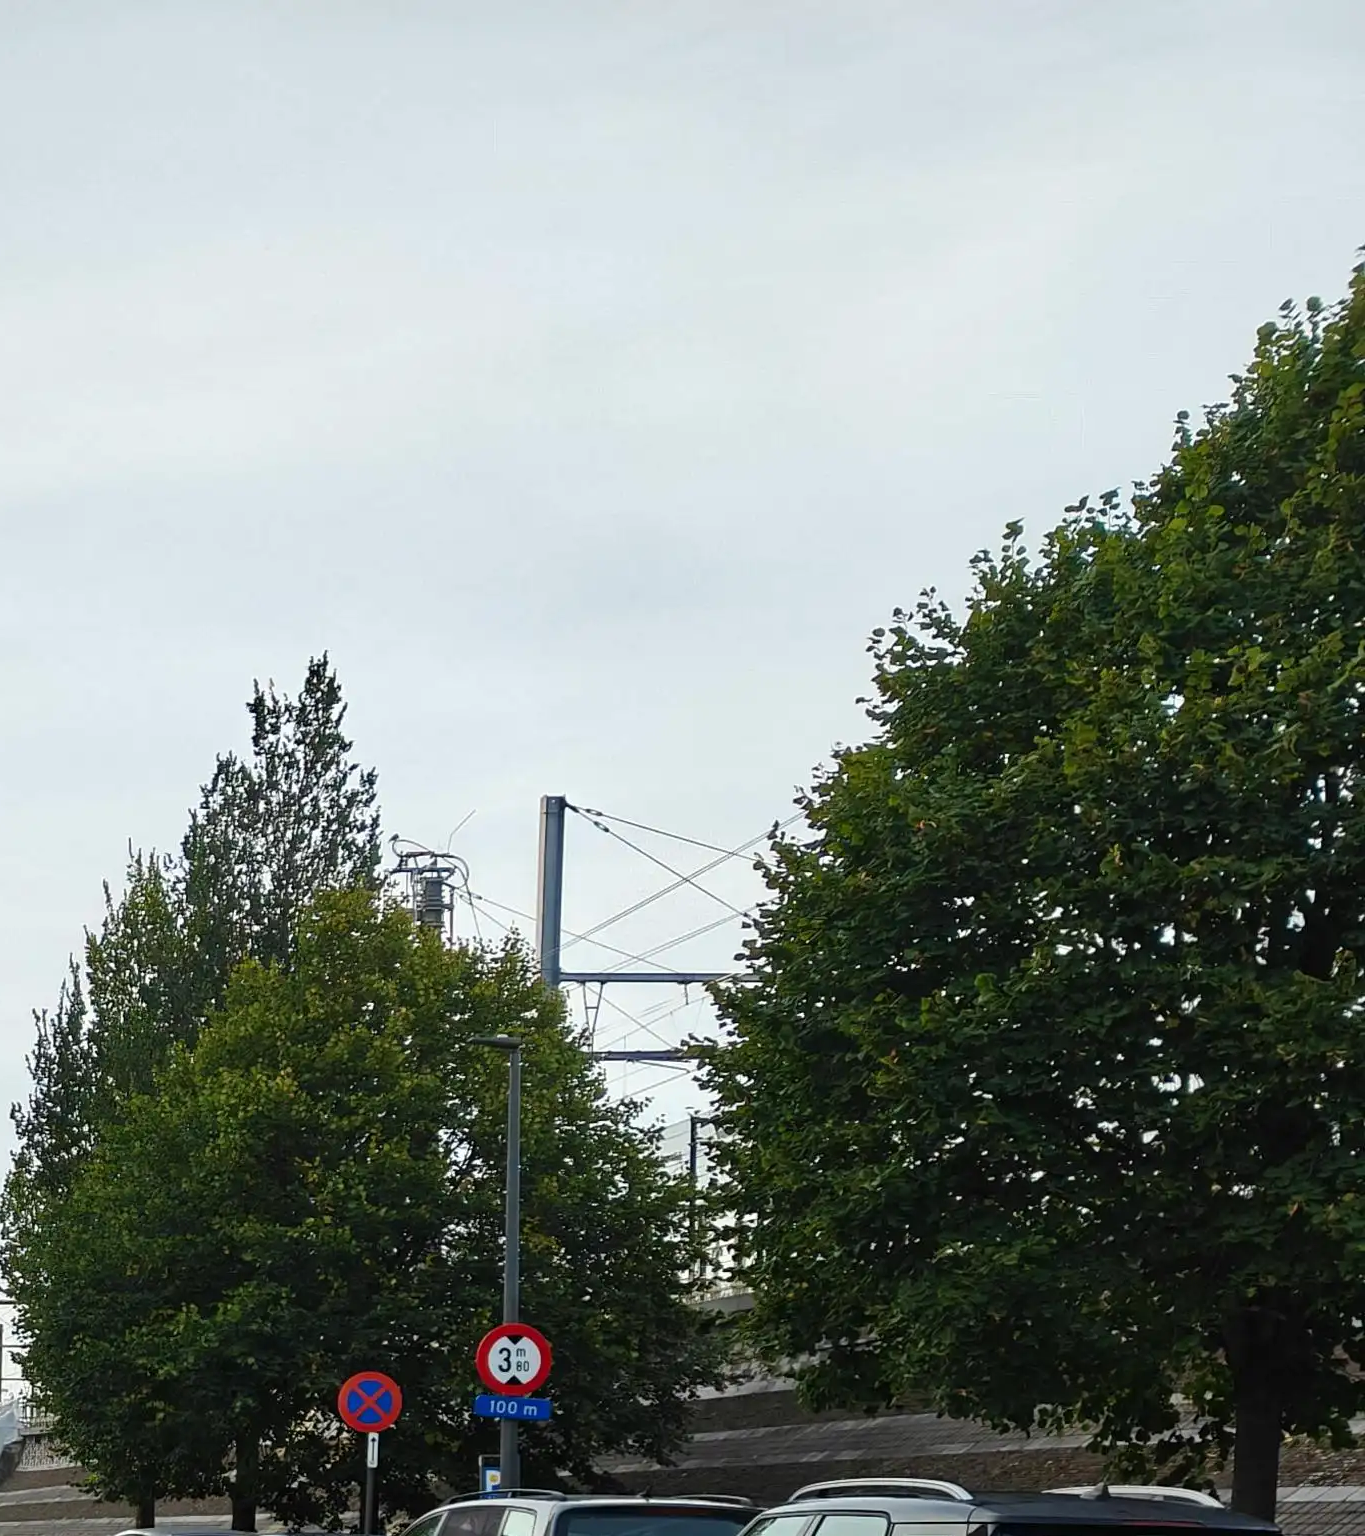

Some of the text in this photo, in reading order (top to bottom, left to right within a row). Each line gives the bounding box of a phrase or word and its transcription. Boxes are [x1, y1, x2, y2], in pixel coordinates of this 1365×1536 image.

[498, 1347, 527, 1373] 3 m
[490, 1400, 538, 1416] 100 m
